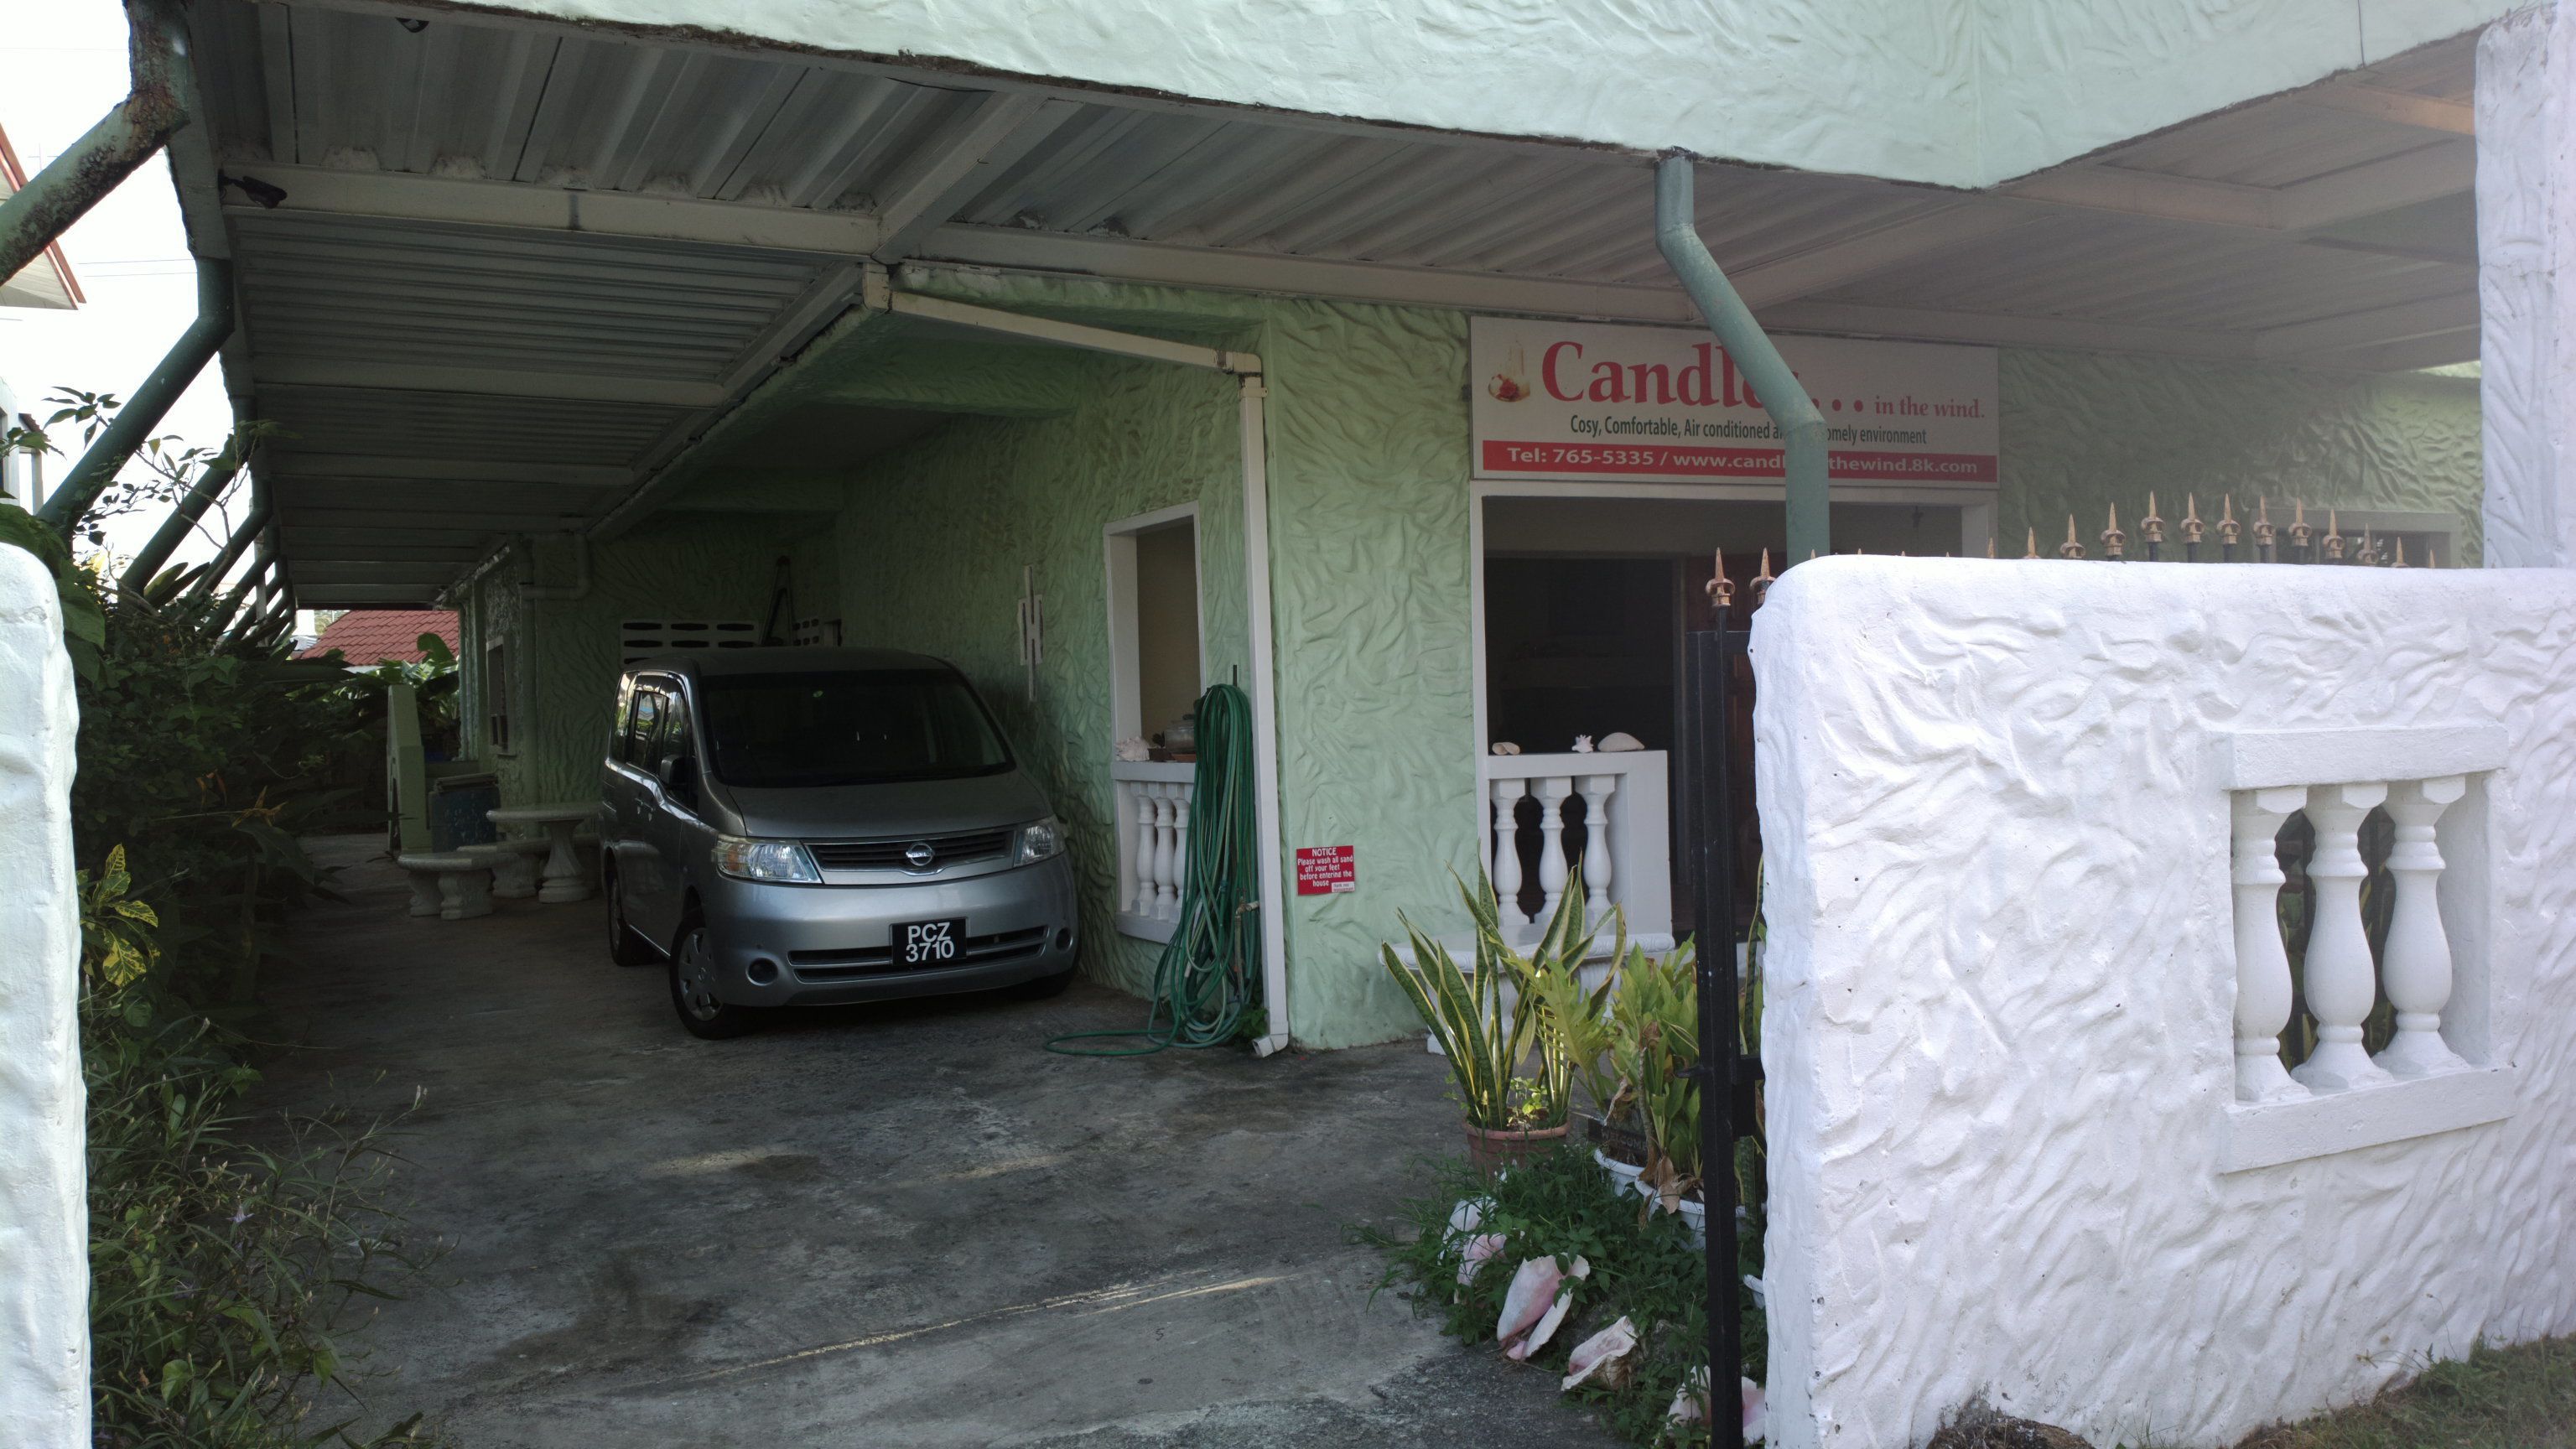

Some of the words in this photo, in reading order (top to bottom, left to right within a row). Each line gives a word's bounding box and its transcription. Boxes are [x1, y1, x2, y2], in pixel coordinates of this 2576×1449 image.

[1875, 395, 1893, 415] in
[1900, 396, 1929, 417] the
[1935, 398, 1985, 418] wind.
[1570, 414, 1602, 439] Cosy,
[1604, 415, 1680, 439] Comfortable,
[1684, 418, 1701, 437] Air
[1703, 420, 1770, 439] conditioned
[1860, 425, 1927, 444] environment
[1507, 447, 1546, 463] Tel:
[1553, 449, 1654, 465] 765-5335
[1297, 858, 1315, 866] Please
[1311, 848, 1337, 856] NOTICE
[1300, 872, 1318, 880] before
[1319, 870, 1342, 879] entering
[907, 922, 951, 944] PCZ
[906, 940, 954, 963] 3710
